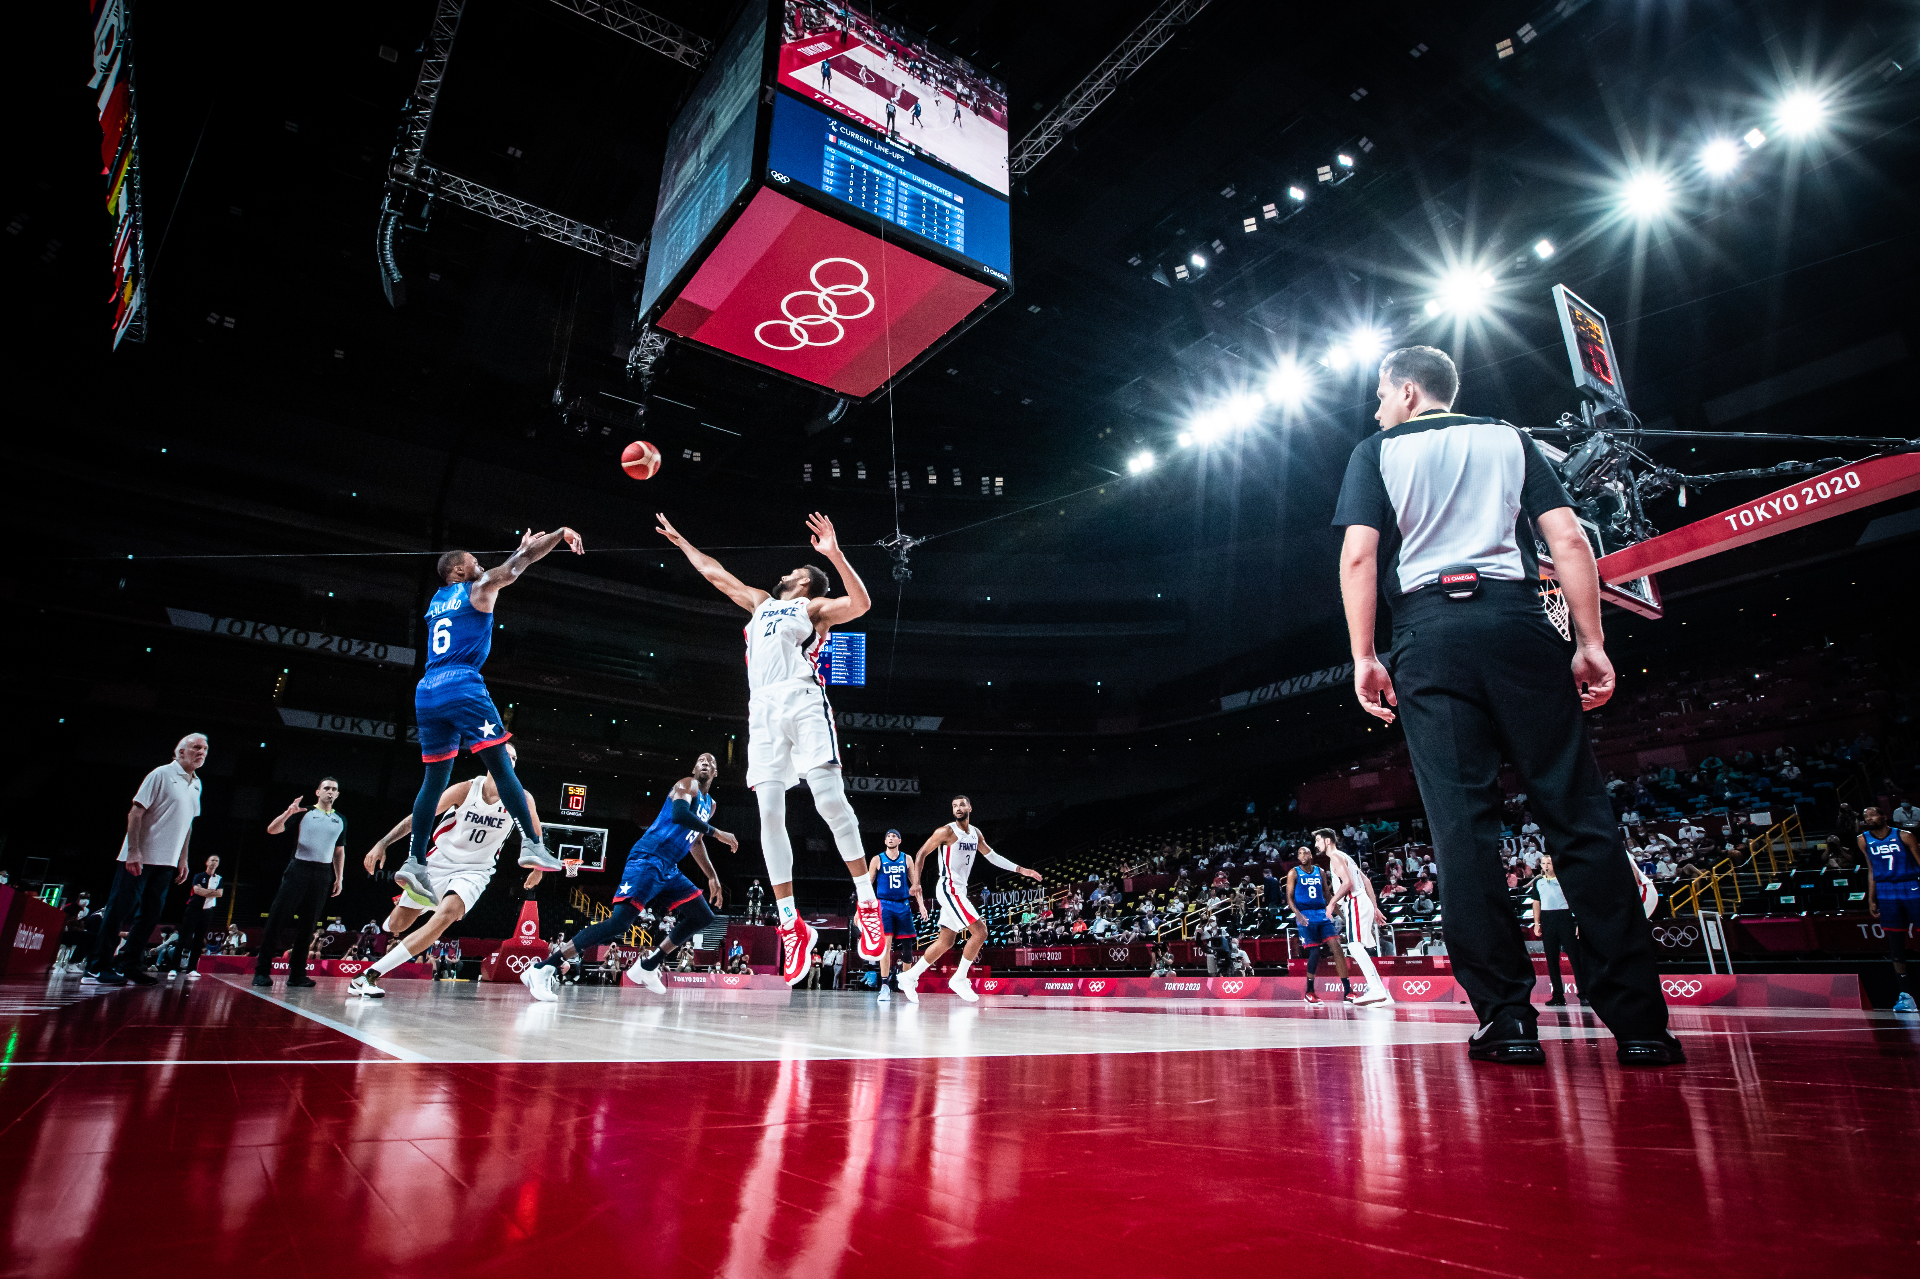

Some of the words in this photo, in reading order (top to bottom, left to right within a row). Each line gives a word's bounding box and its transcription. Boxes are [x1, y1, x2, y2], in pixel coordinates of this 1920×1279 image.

[826, 146, 837, 155] NO.
[839, 126, 873, 147] CURRENT
[874, 143, 905, 162] LINE-UPS
[839, 139, 864, 156] FRANCE
[826, 169, 834, 177] 10
[885, 196, 893, 204] 10
[912, 175, 932, 188] UNITED
[989, 269, 1008, 282] OMEGA
[1588, 342, 1614, 386] 10
[1598, 383, 1625, 406] OMEGA
[1724, 493, 1799, 531] TOKYO
[1801, 471, 1861, 506] 2020
[1451, 574, 1475, 582] OMEGA
[760, 606, 799, 621] FRANCE
[209, 614, 311, 647] TOKYO
[318, 634, 389, 661] 2020
[432, 617, 453, 655] 6
[1246, 673, 1315, 706] TOKYO
[1317, 661, 1355, 687] 202
[317, 713, 398, 739] TOKYO
[863, 713, 915, 729] 2020
[568, 786, 585, 796] 5:39
[875, 777, 920, 793] 2020
[568, 796, 583, 810] 10
[464, 810, 506, 829] FRANCE
[468, 828, 487, 844] 10
[1870, 843, 1901, 856] USA
[965, 854, 971, 866] 3
[1881, 855, 1894, 871] 7
[883, 865, 906, 874] USA
[888, 874, 902, 889] 15
[1300, 877, 1321, 886] USA
[991, 892, 1020, 908] TOKYO
[1020, 889, 1045, 905] 2020
[1308, 886, 1317, 899] 8
[1046, 951, 1062, 961] 2020
[1044, 982, 1060, 990] TOKYO
[1060, 982, 1074, 990] 2020
[1164, 982, 1185, 991] TOKYO
[1185, 982, 1201, 991] 2020
[1324, 983, 1346, 992] TOKY
